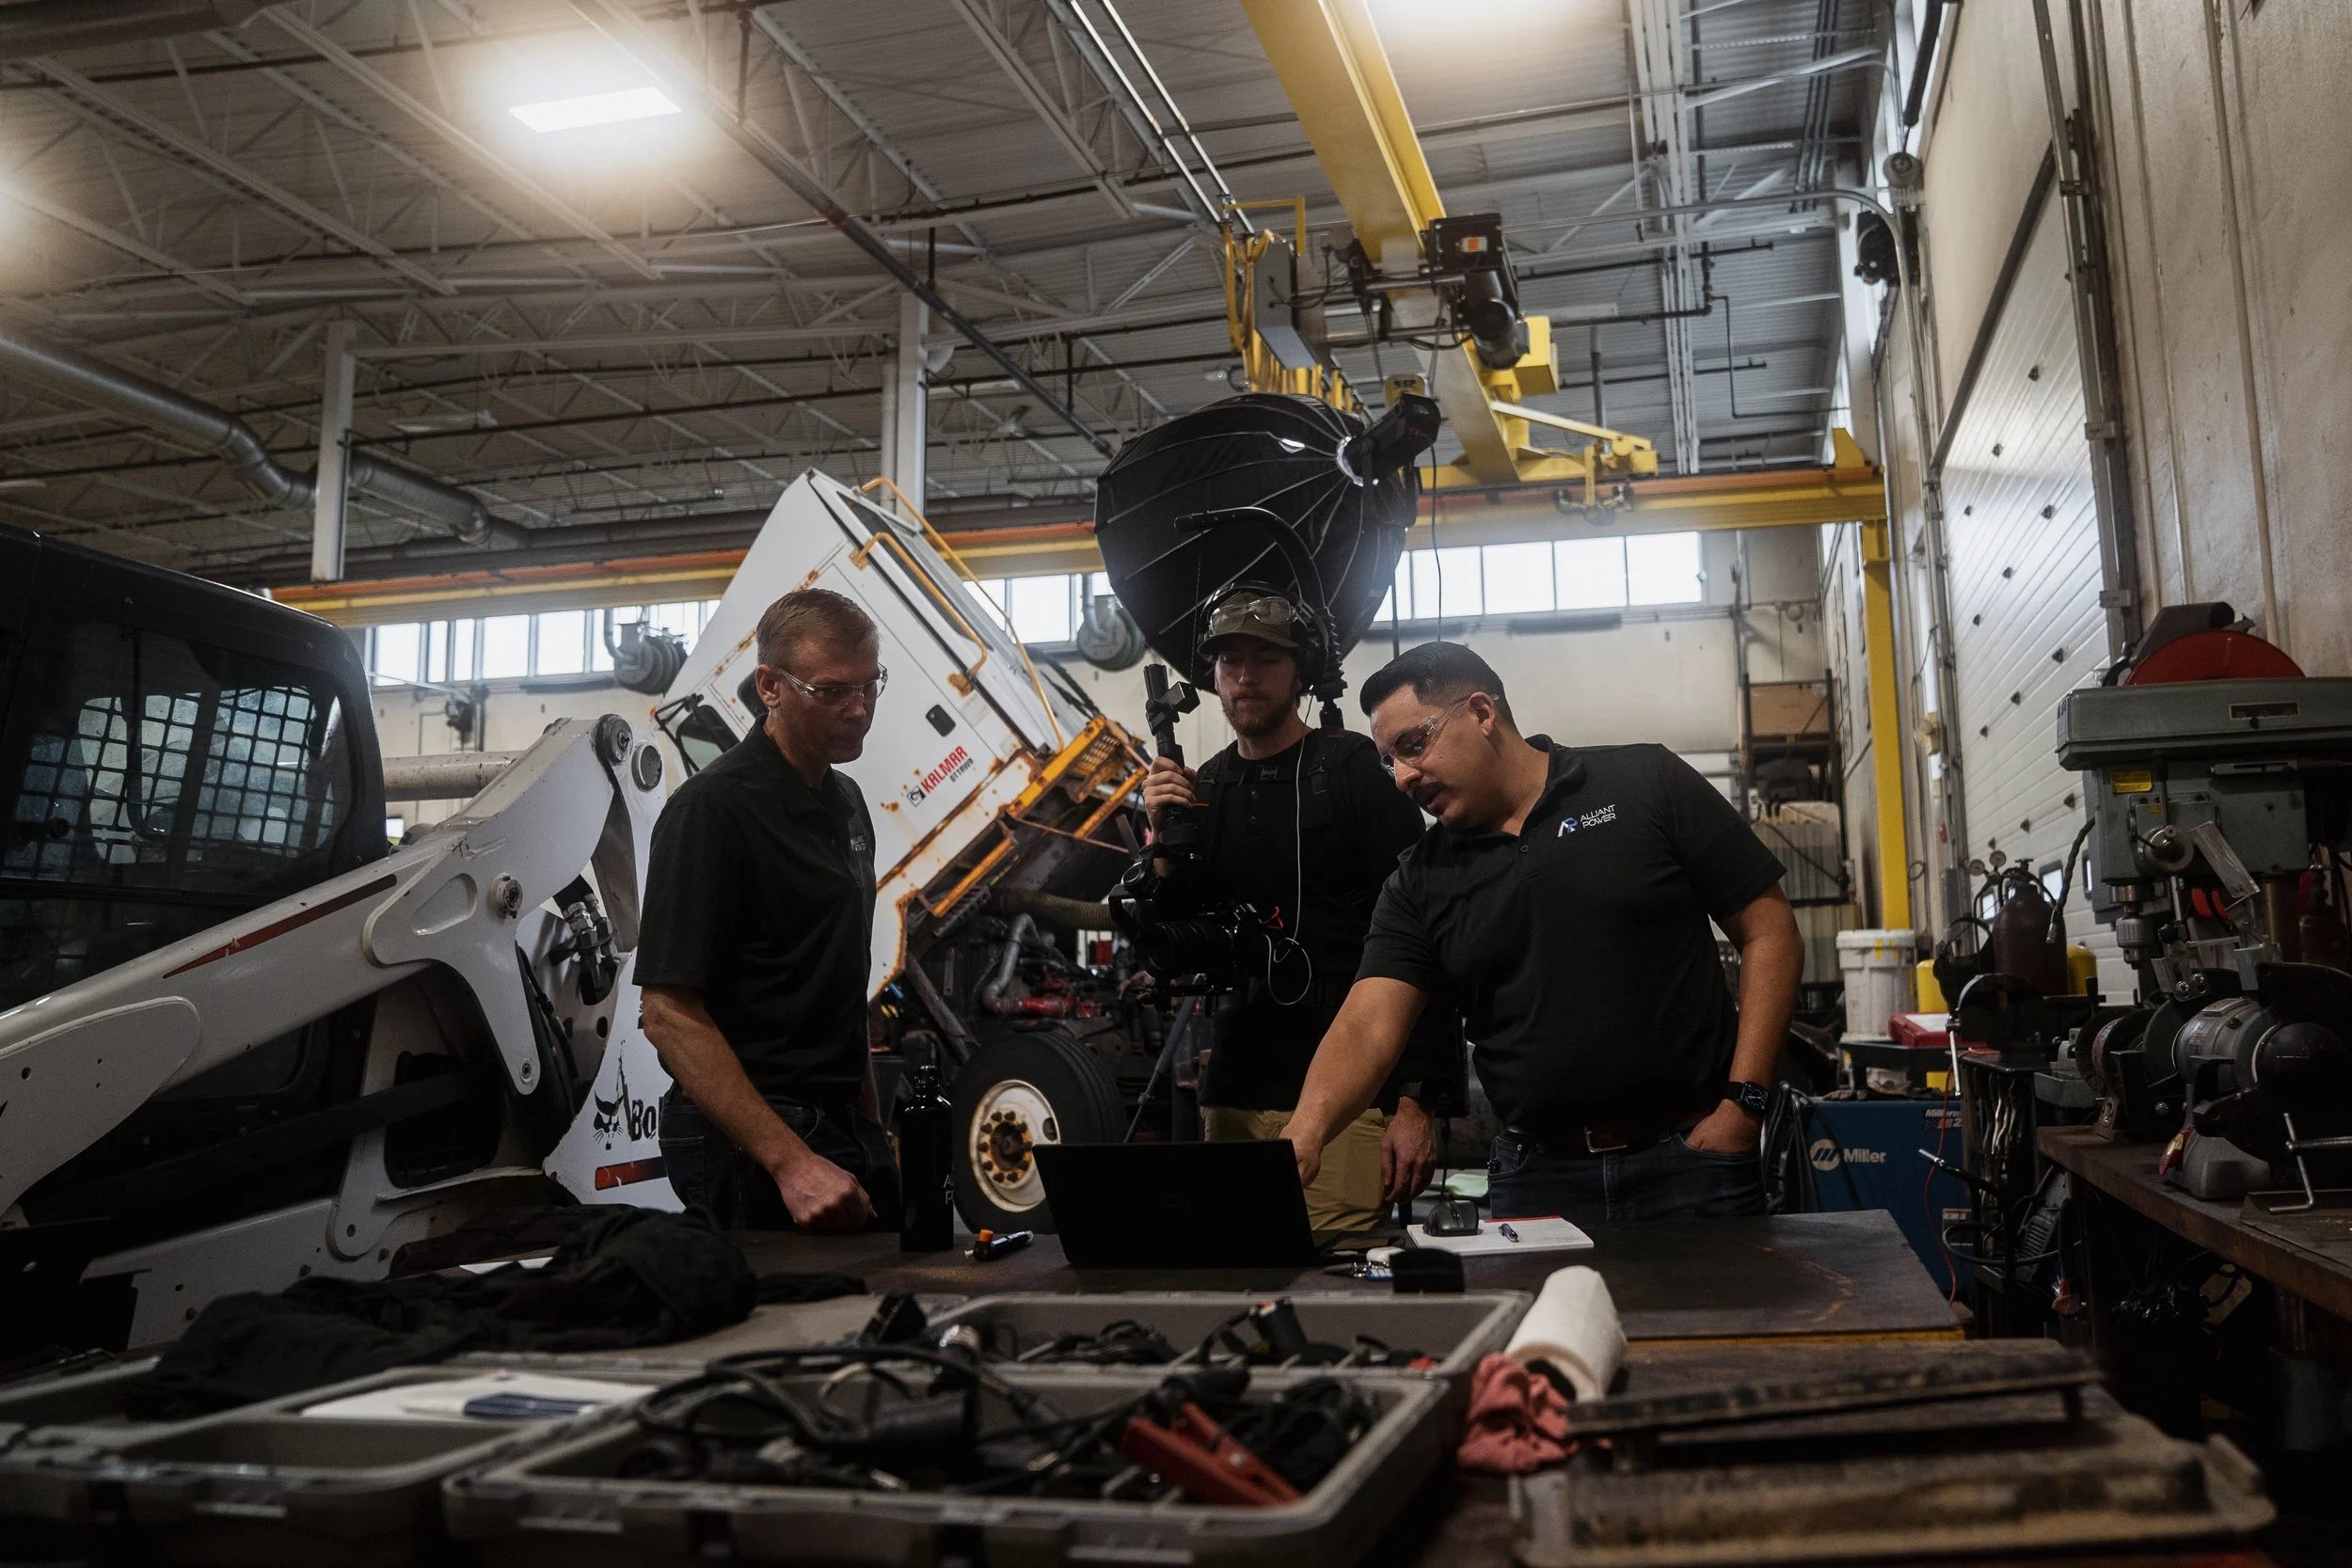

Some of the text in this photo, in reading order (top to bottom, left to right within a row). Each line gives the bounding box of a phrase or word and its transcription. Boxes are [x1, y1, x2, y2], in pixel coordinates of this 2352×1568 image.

[921, 745, 968, 793] KALMAR
[949, 757, 975, 783] OTTAWA
[1581, 804, 1615, 822] ALLIANT
[1581, 813, 1616, 828] POWER
[1843, 1148, 1887, 1164] Miller
